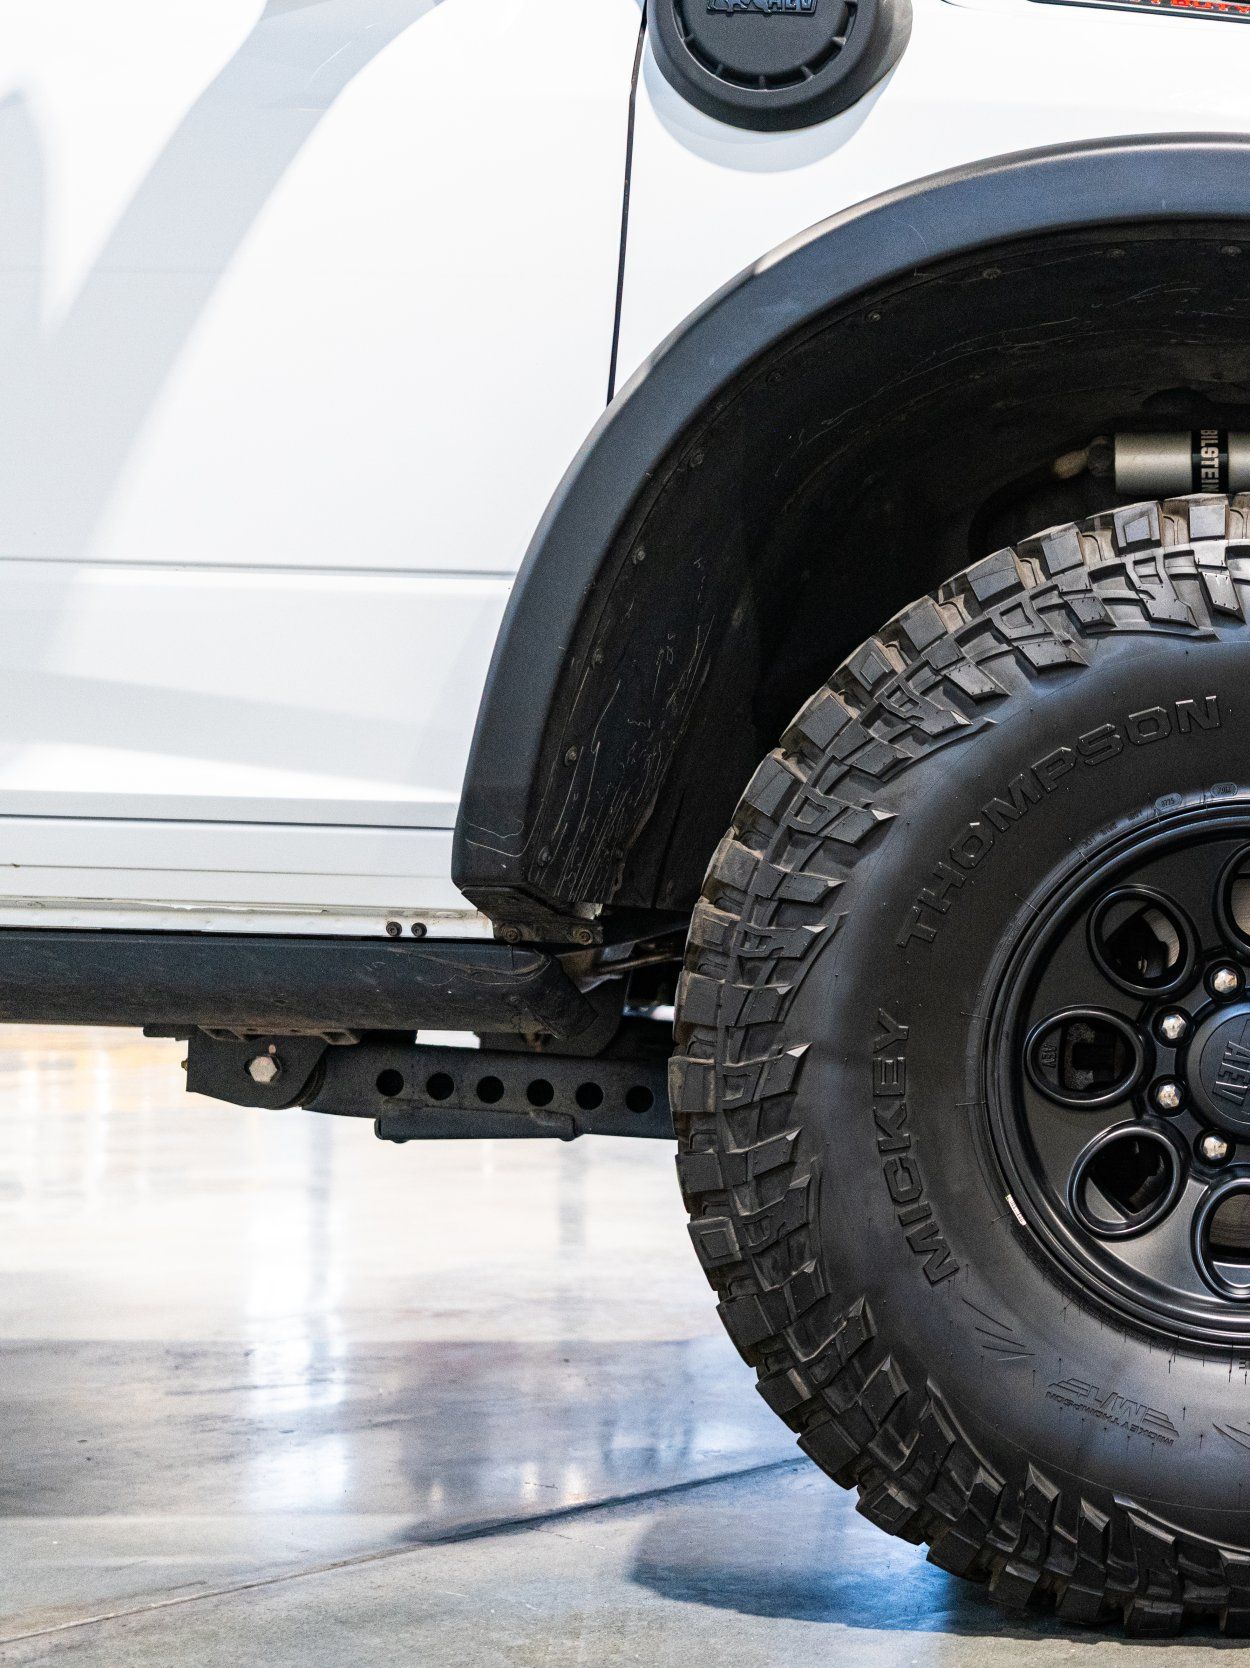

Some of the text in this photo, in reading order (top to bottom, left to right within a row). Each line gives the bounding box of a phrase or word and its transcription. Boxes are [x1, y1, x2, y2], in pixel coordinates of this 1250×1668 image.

[1200, 429, 1219, 492] BILSTEIN
[872, 694, 1222, 1286] MICKEY THOMPSON
[1045, 1391, 1175, 1447] MICKEY THOMPSON
